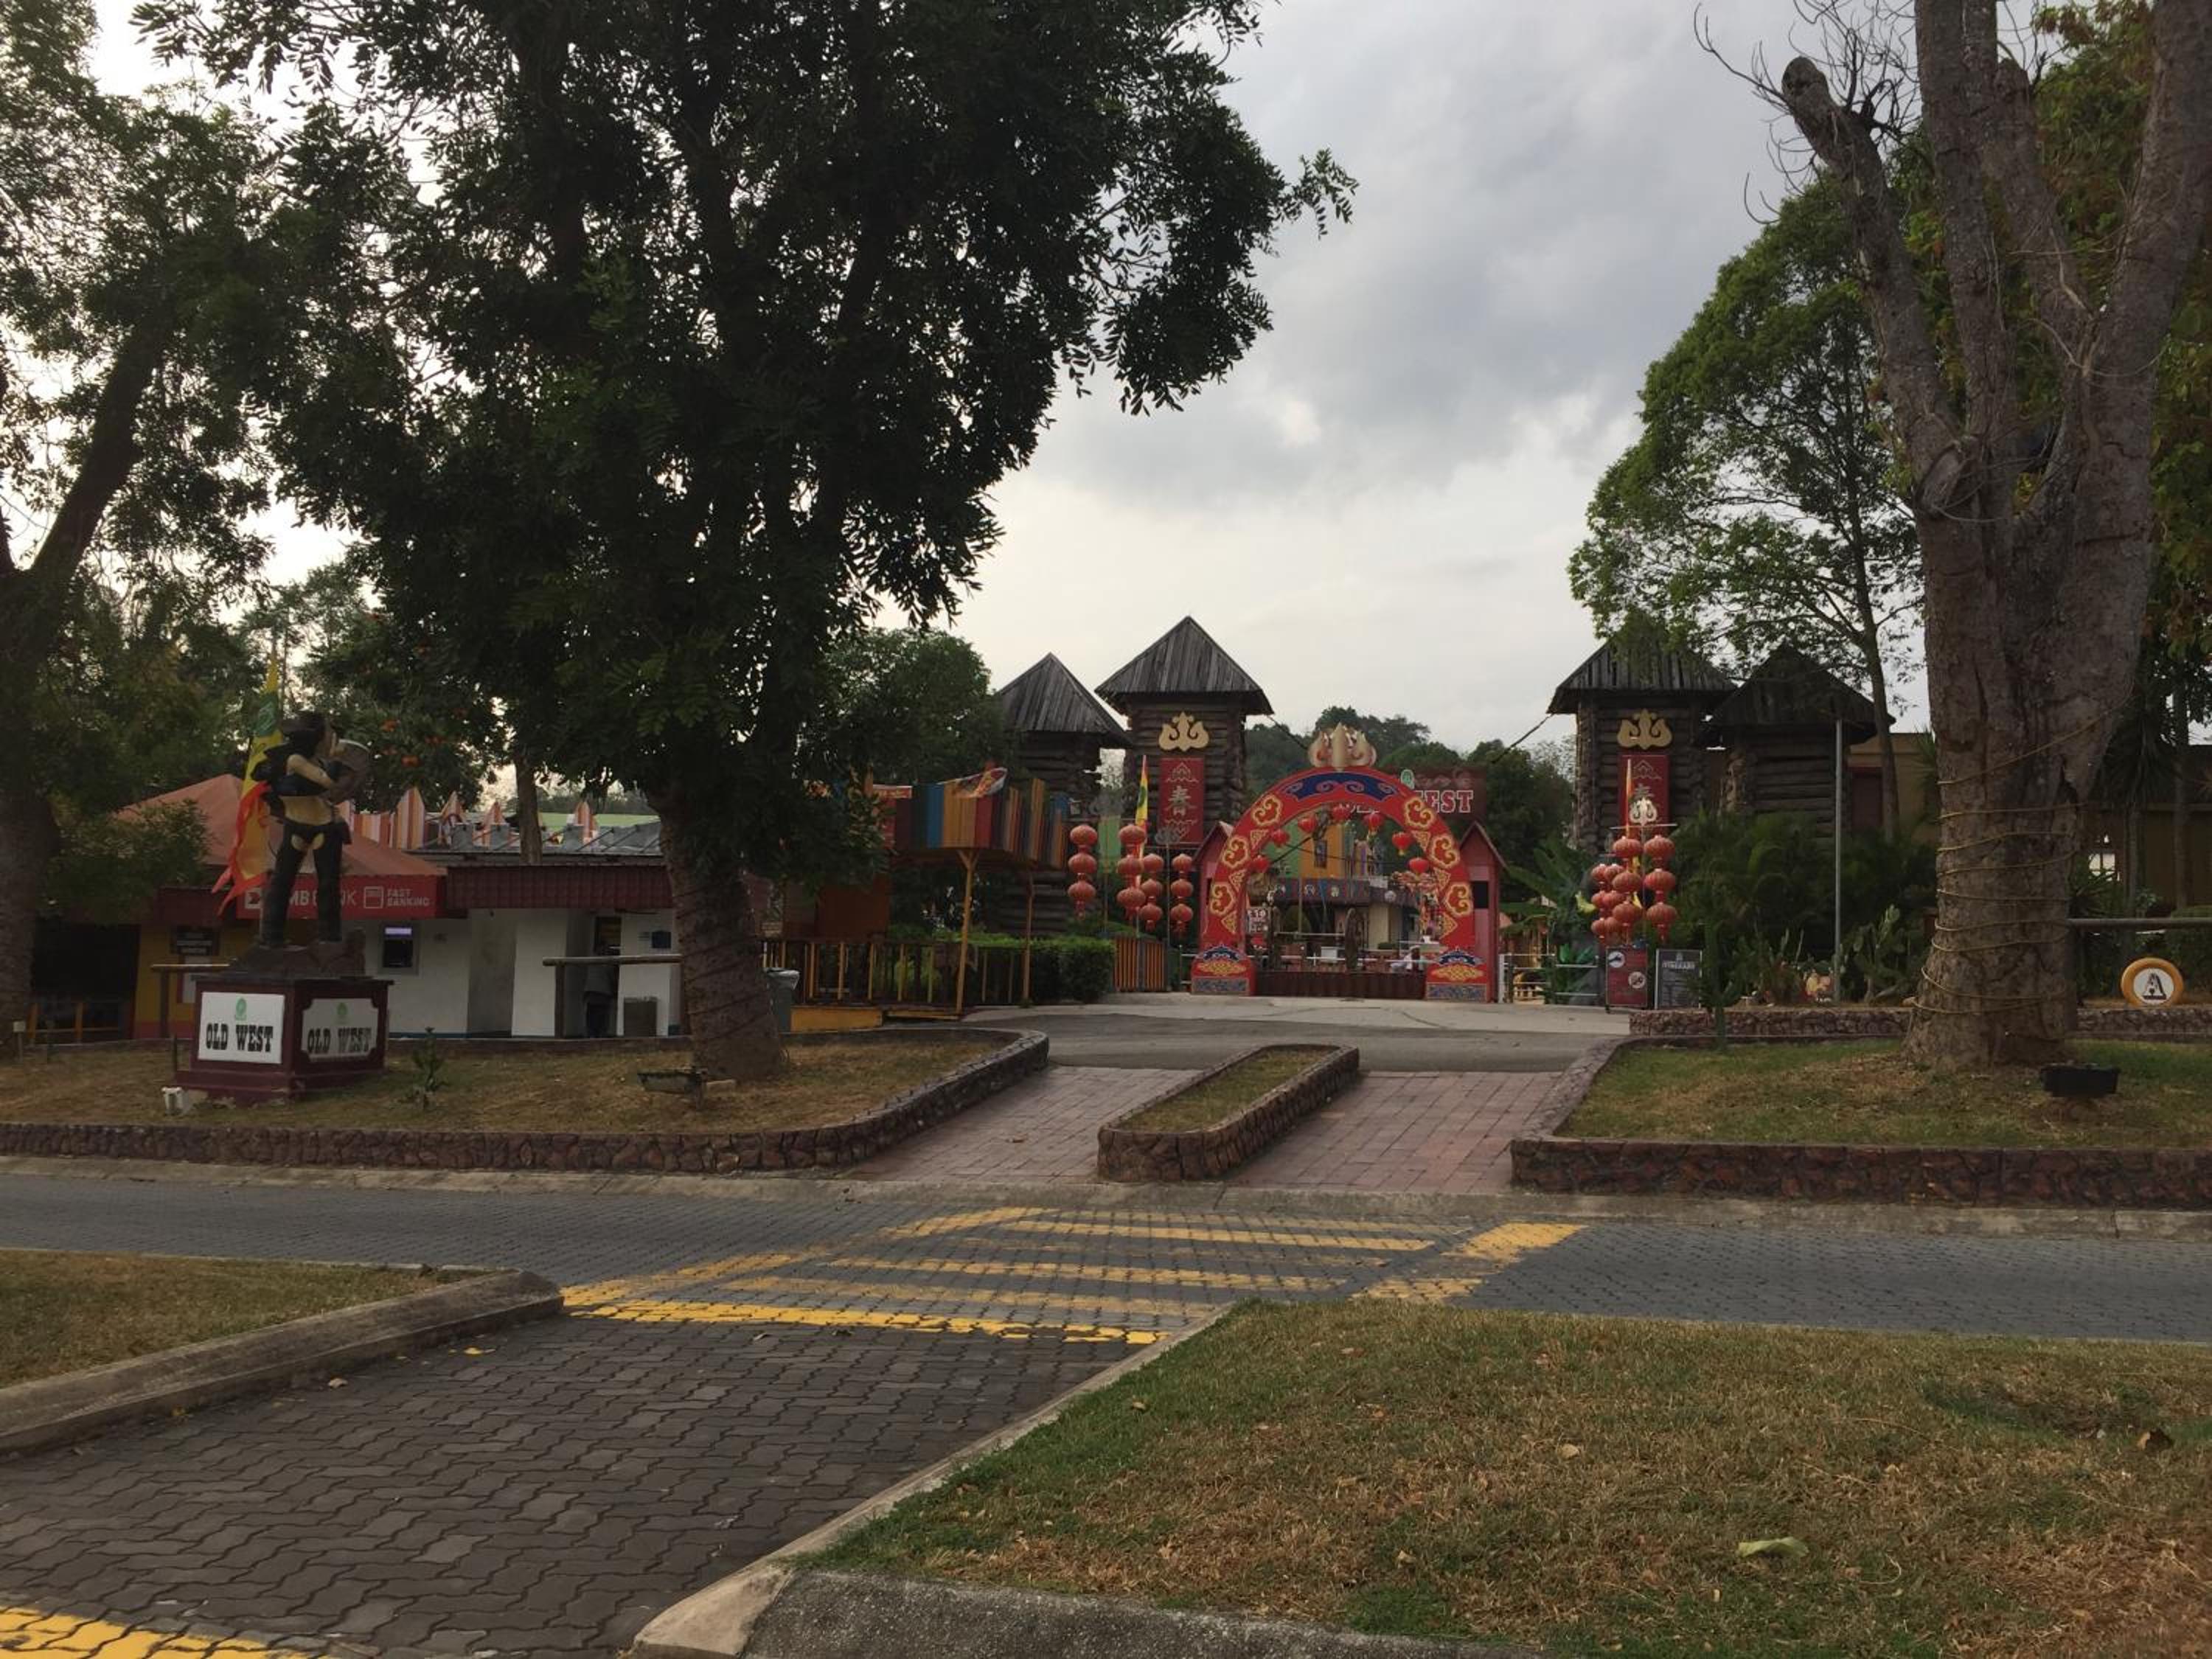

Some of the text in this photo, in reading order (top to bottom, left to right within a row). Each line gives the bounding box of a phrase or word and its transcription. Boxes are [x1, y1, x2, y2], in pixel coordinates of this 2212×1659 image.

[1413, 790, 1474, 814] EST
[387, 888, 413, 897] FAST
[206, 1023, 274, 1052] OLD WEST
[307, 1027, 372, 1054] OLD WEST
